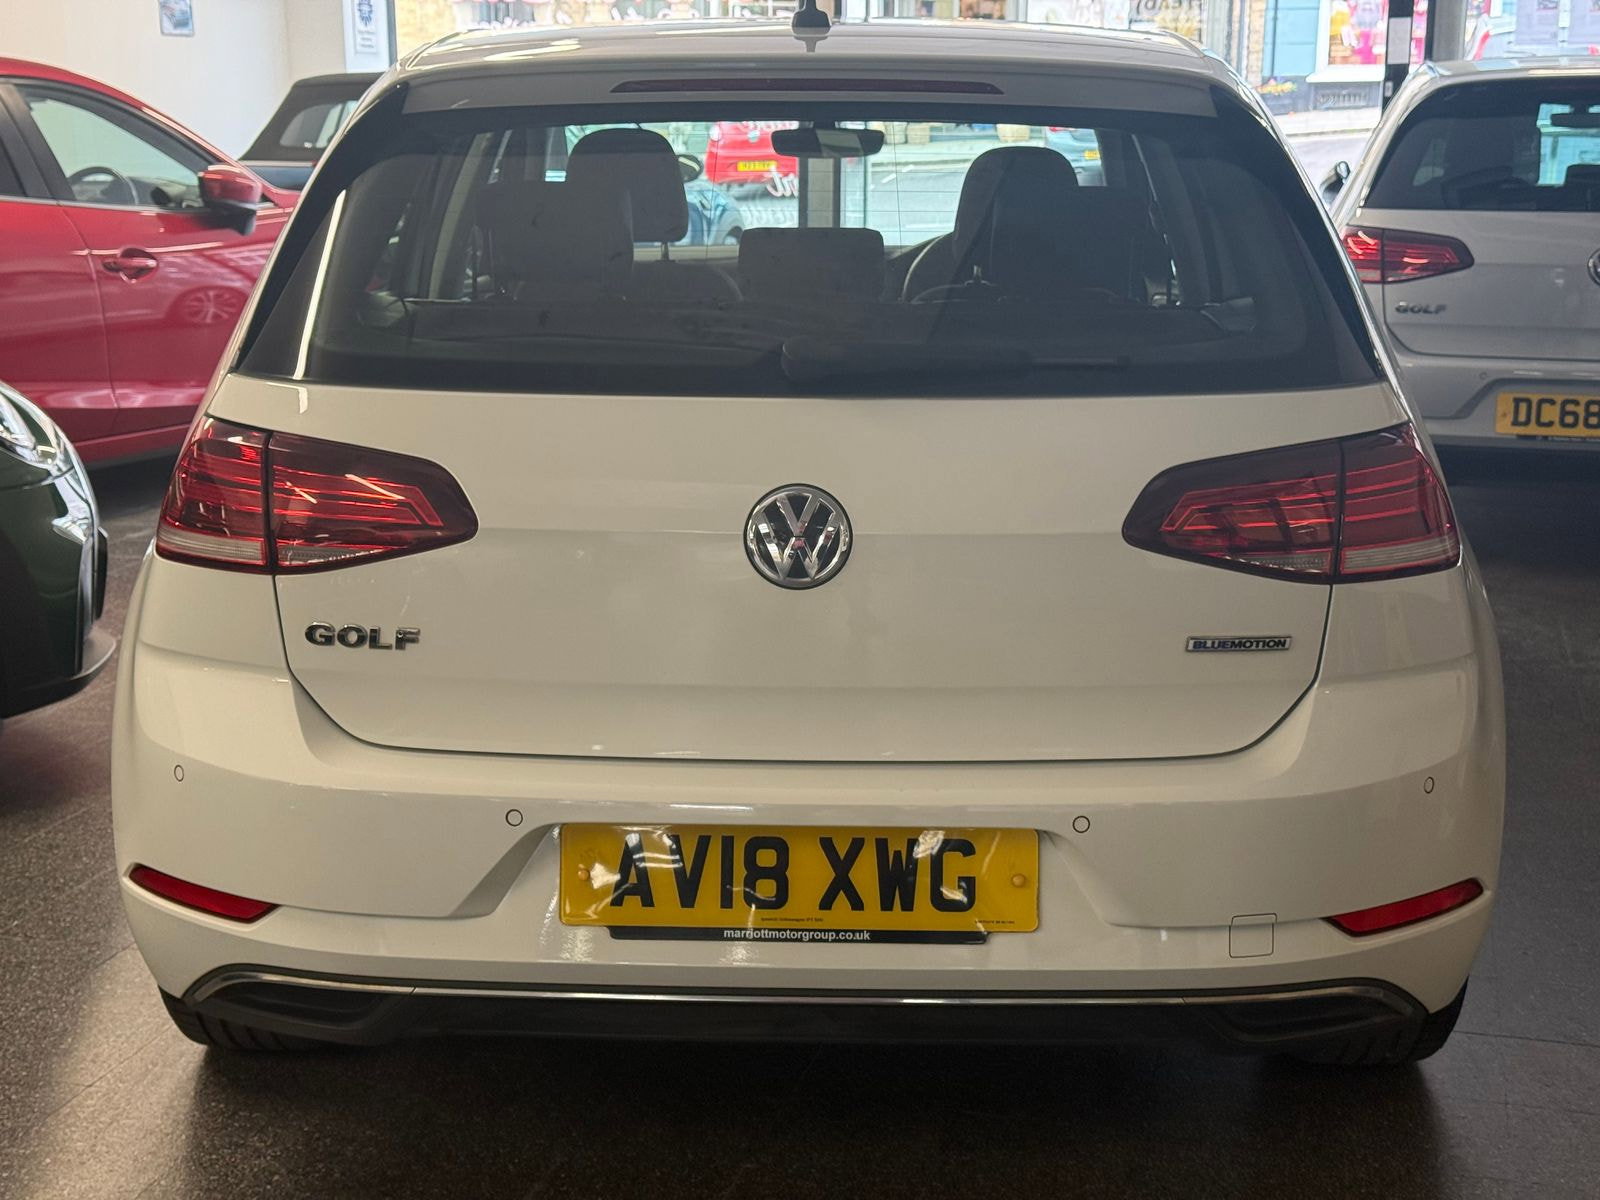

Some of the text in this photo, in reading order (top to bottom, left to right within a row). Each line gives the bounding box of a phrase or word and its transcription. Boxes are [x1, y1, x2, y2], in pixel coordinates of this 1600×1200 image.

[1395, 302, 1447, 314] GOLF
[1511, 397, 1600, 429] DC68
[304, 621, 420, 651] GOLF
[1191, 638, 1288, 650] BLUEMOTION
[610, 832, 977, 913] AV18 XWG
[723, 928, 872, 942] marriottmotorgroup.co.uk
